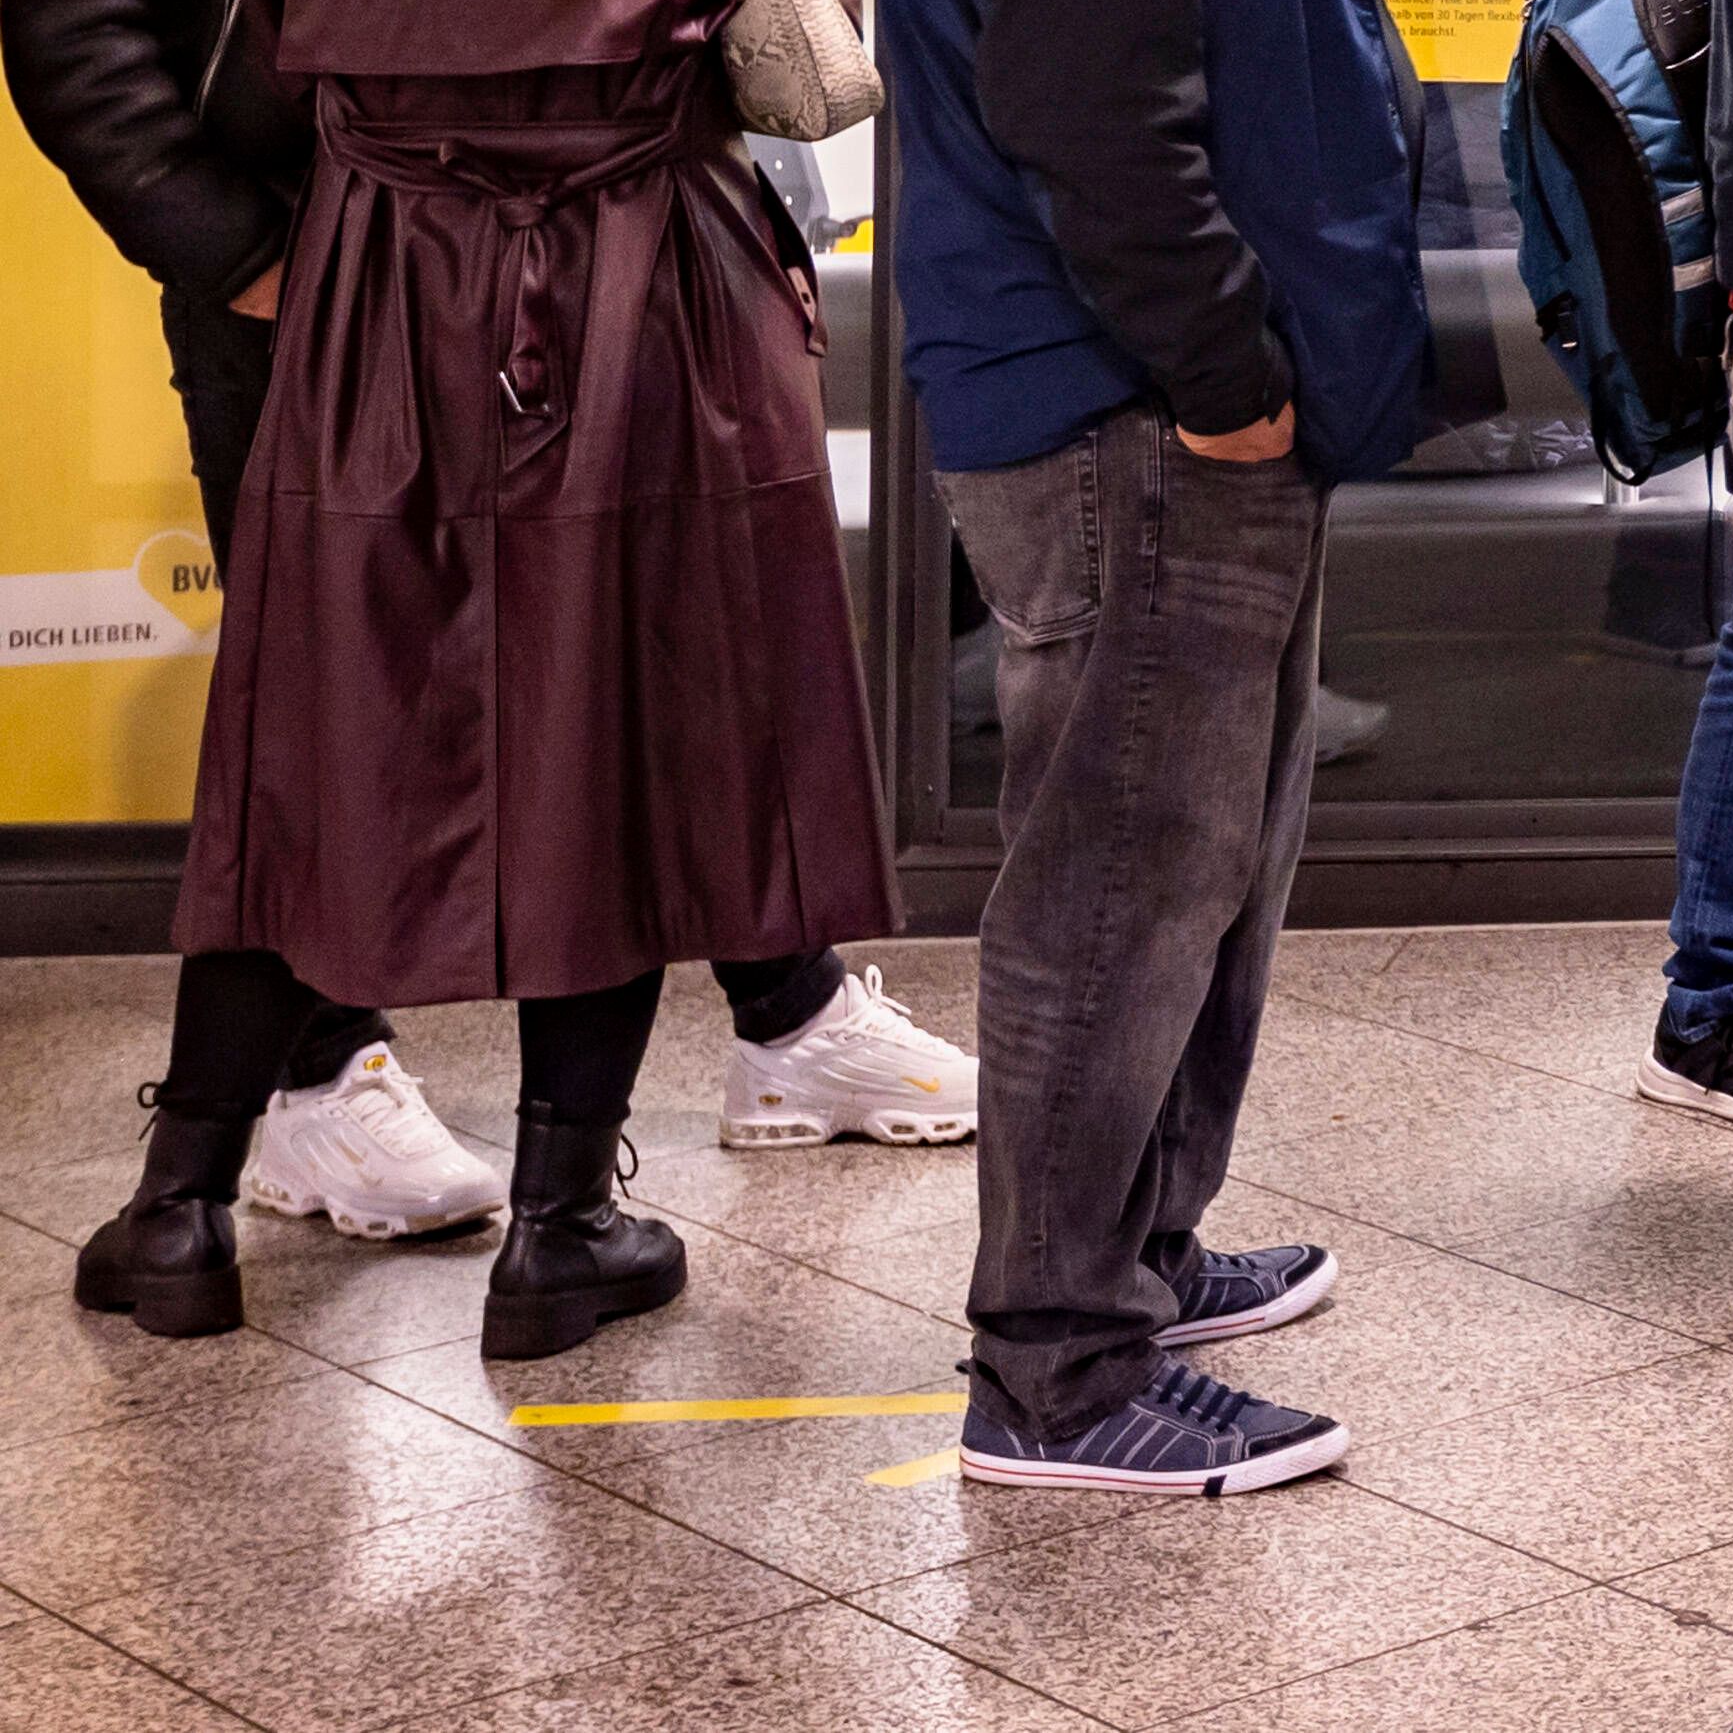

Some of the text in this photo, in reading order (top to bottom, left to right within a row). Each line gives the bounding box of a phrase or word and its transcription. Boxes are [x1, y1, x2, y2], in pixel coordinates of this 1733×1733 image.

[1415, 11, 1435, 22] von
[1437, 9, 1450, 22] 30
[1453, 9, 1485, 24] Tagen
[1409, 25, 1458, 38] brauchst.
[9, 626, 64, 650] DICH
